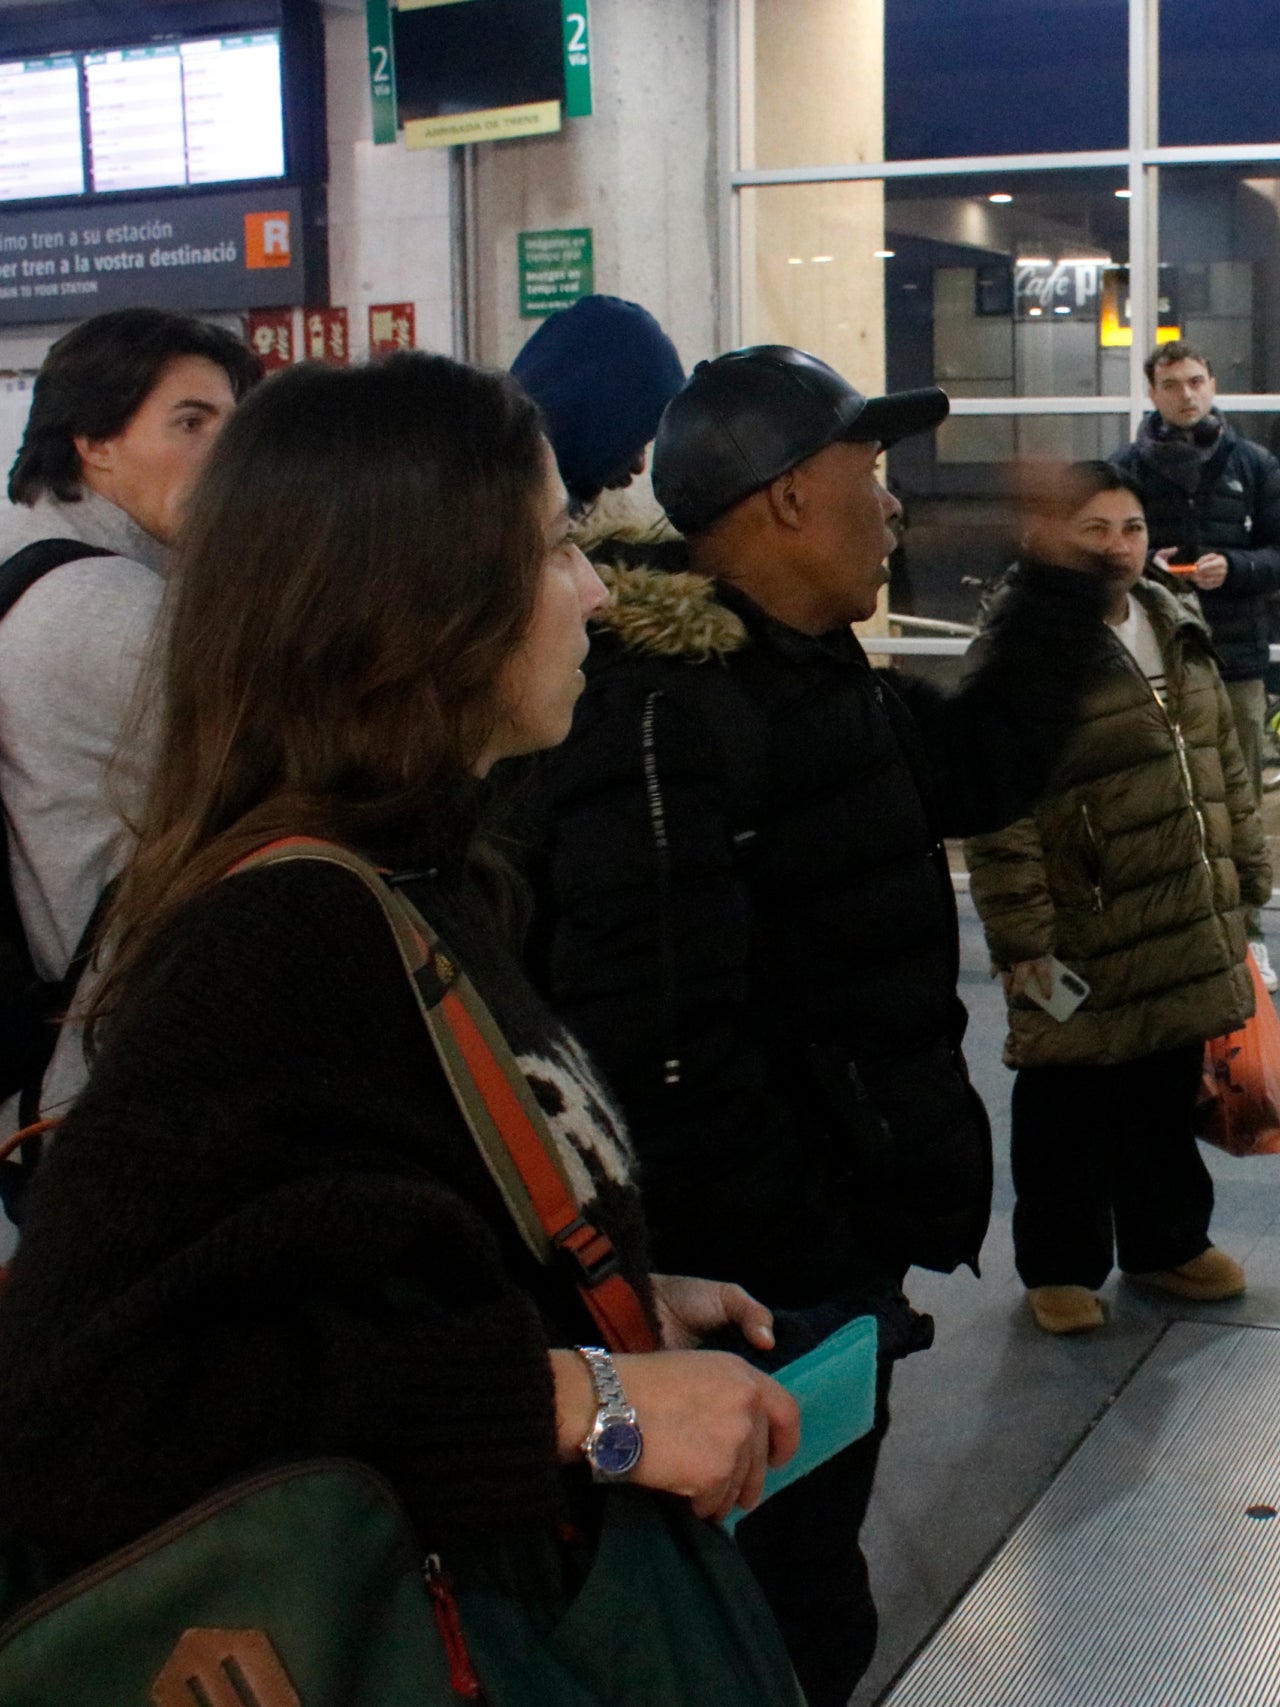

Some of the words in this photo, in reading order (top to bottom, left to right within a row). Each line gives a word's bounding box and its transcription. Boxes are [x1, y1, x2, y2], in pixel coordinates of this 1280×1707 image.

[567, 13, 587, 51] 2
[371, 46, 389, 82] 2
[31, 231, 64, 250] tren
[69, 231, 79, 247] a
[83, 229, 101, 246] su
[105, 218, 173, 244] estación
[263, 219, 290, 254] R
[22, 257, 55, 277] tren
[60, 258, 70, 274] a
[75, 253, 90, 273] la
[94, 252, 145, 272] vostra
[150, 239, 237, 268] destinació
